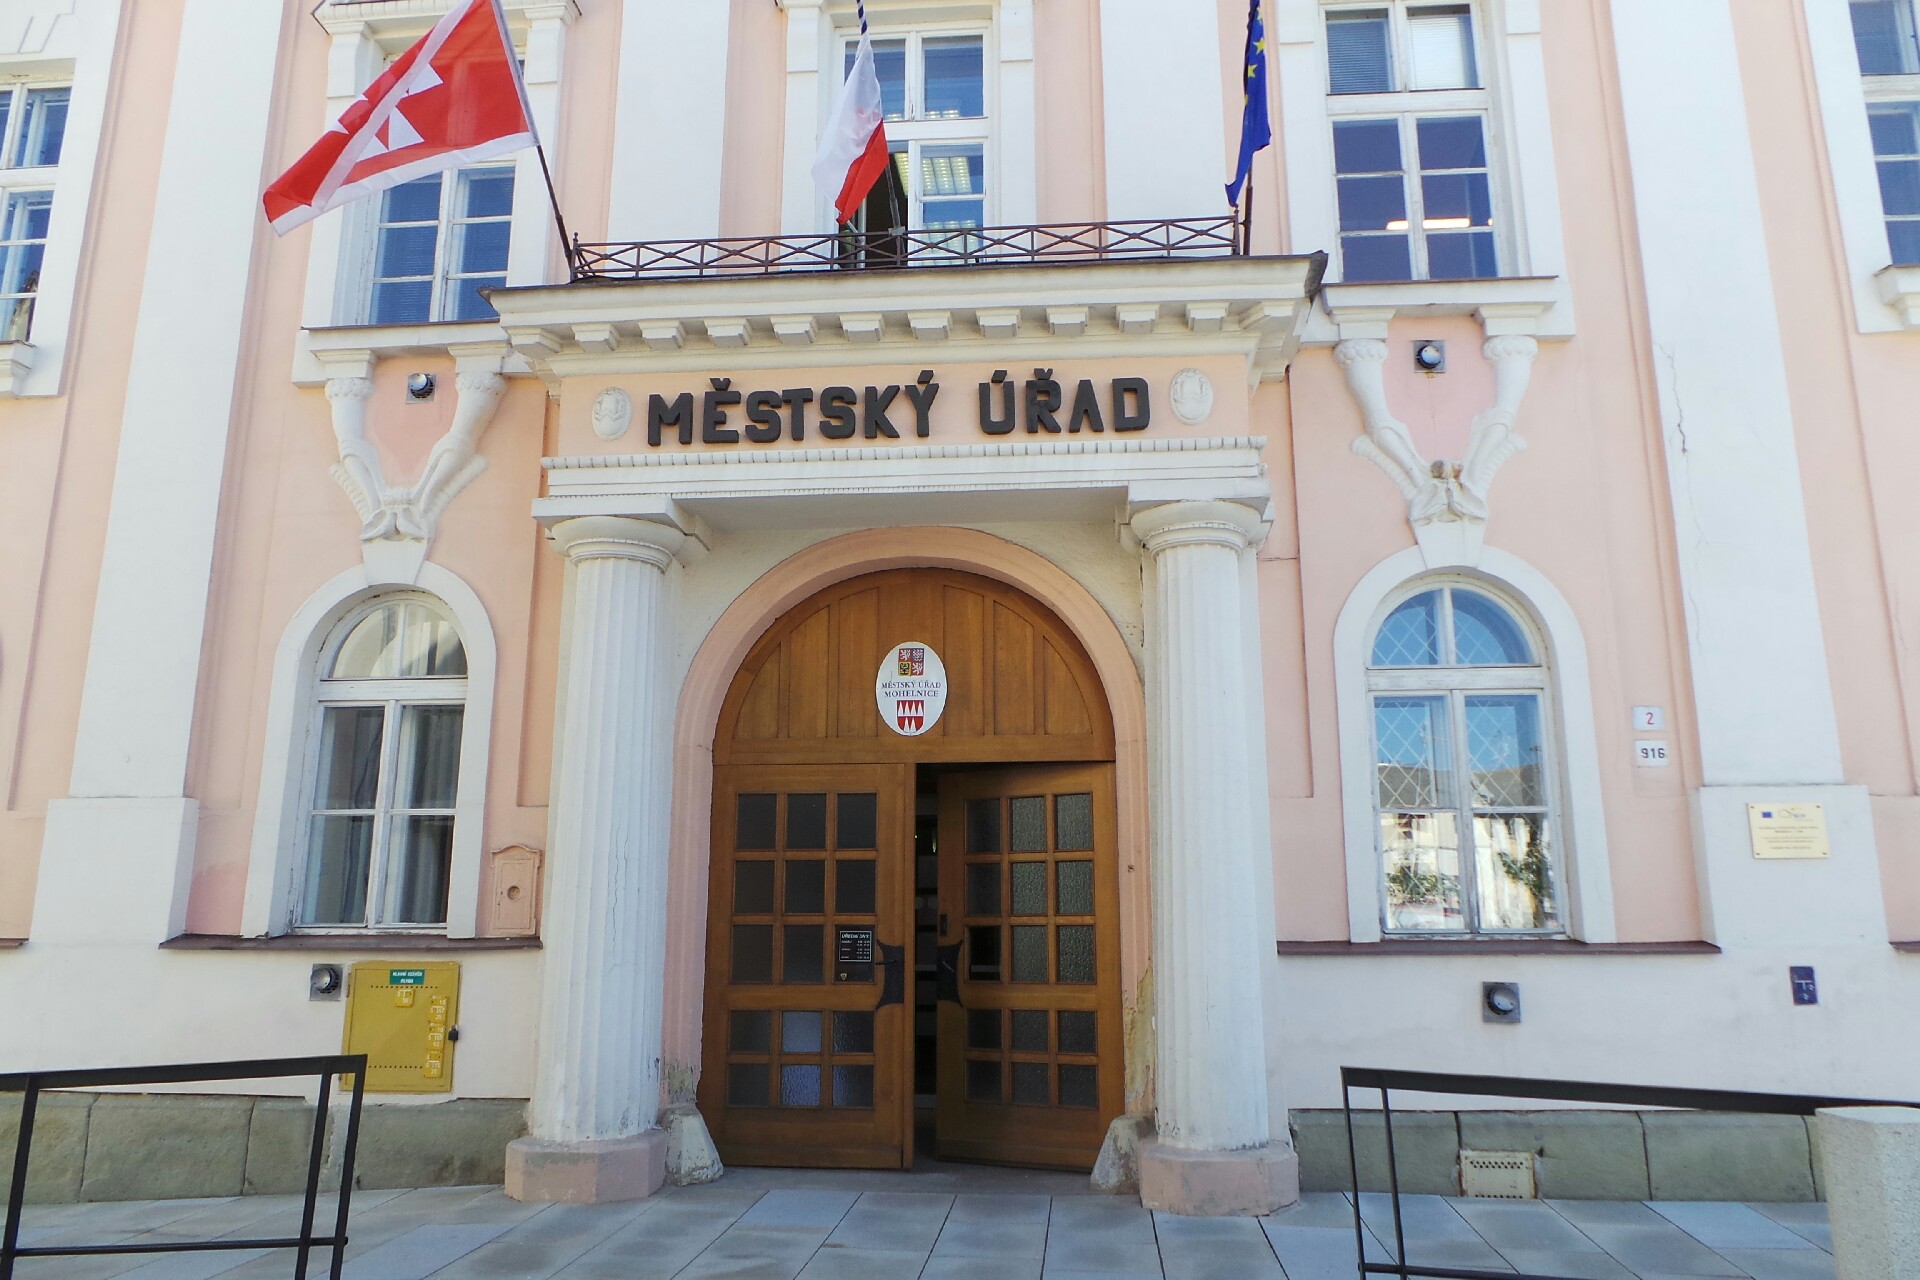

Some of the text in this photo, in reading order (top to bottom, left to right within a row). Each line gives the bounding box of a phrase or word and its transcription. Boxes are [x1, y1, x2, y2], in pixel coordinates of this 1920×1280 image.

[647, 368, 1151, 446] MĚSTSKÝ ÚŘAD
[881, 680, 941, 689] MĚSTSKÝ ÚŘAD
[884, 690, 939, 698] MOHELNICE
[1645, 711, 1654, 725] 2
[1640, 747, 1666, 759] 916
